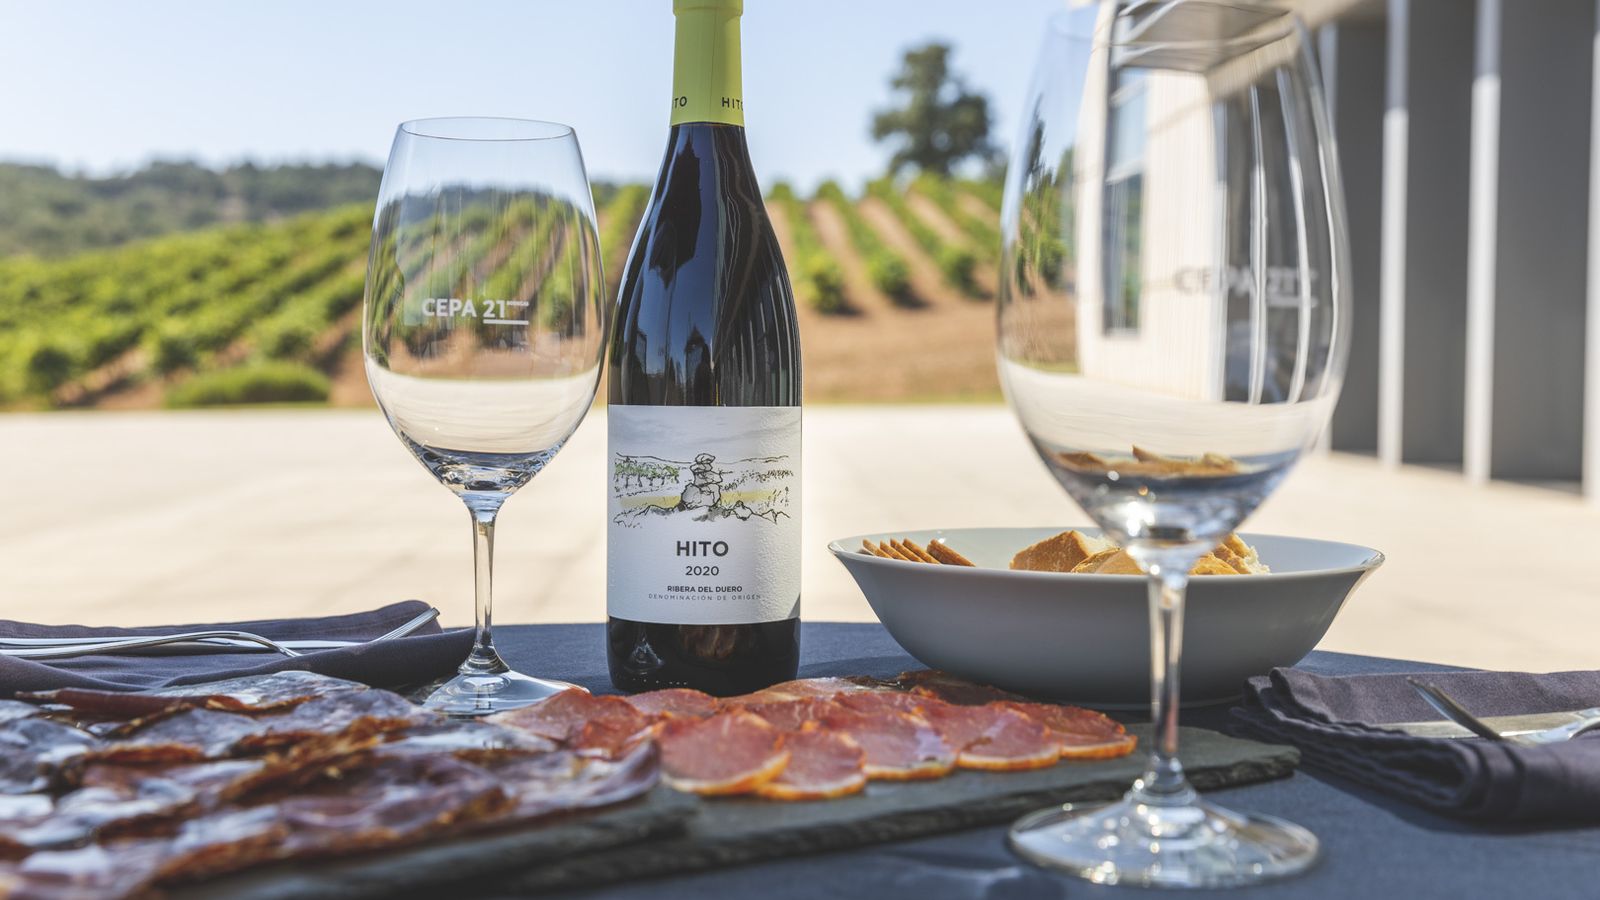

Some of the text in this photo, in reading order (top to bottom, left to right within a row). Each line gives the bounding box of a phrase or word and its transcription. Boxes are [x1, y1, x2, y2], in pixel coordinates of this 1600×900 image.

[672, 96, 688, 109] TO
[421, 298, 505, 318] CEPA 21
[676, 540, 729, 557] HITO
[685, 565, 720, 576] 2020
[667, 585, 696, 593] RIBERA
[648, 593, 713, 601] DENOMINACIÓN
